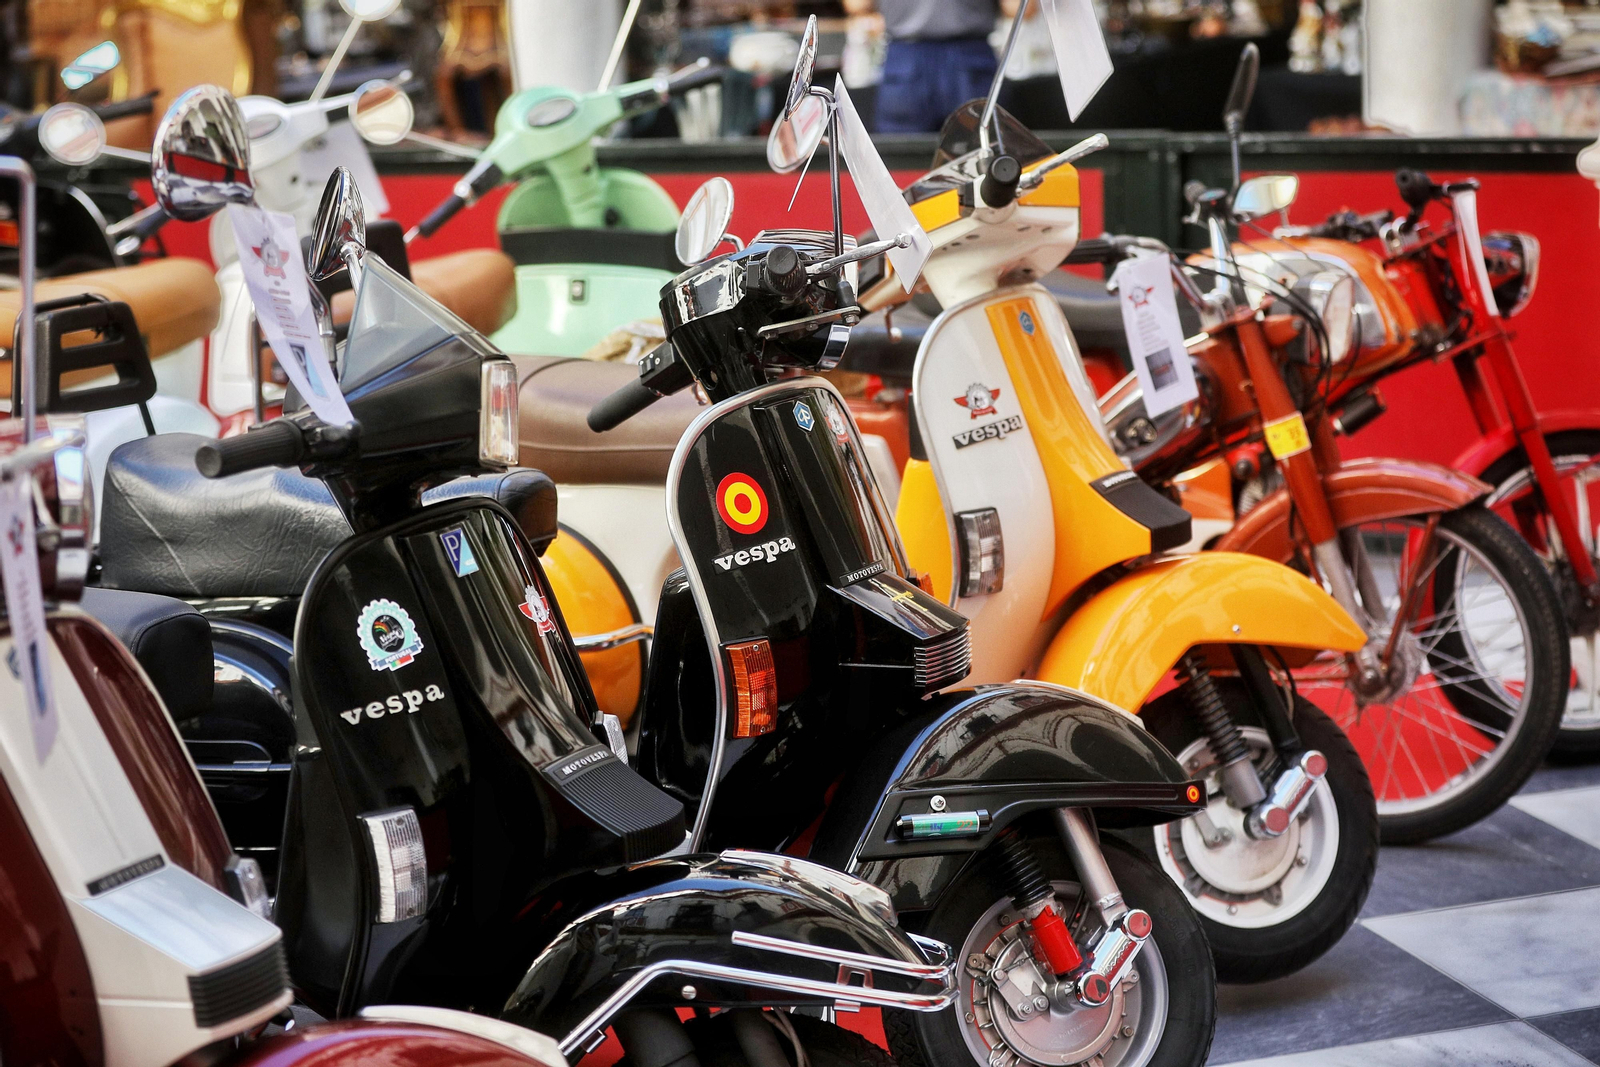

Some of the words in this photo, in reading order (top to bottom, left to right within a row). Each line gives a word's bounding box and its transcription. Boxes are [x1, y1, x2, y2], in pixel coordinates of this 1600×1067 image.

[954, 415, 1022, 445] vespa
[714, 536, 796, 571] vespa
[846, 563, 884, 583] MOTOVESPA
[384, 648, 413, 664] PORTUGAL
[340, 684, 445, 725] vespa
[561, 750, 609, 776] MOTOVESPA
[956, 819, 974, 831] 22
